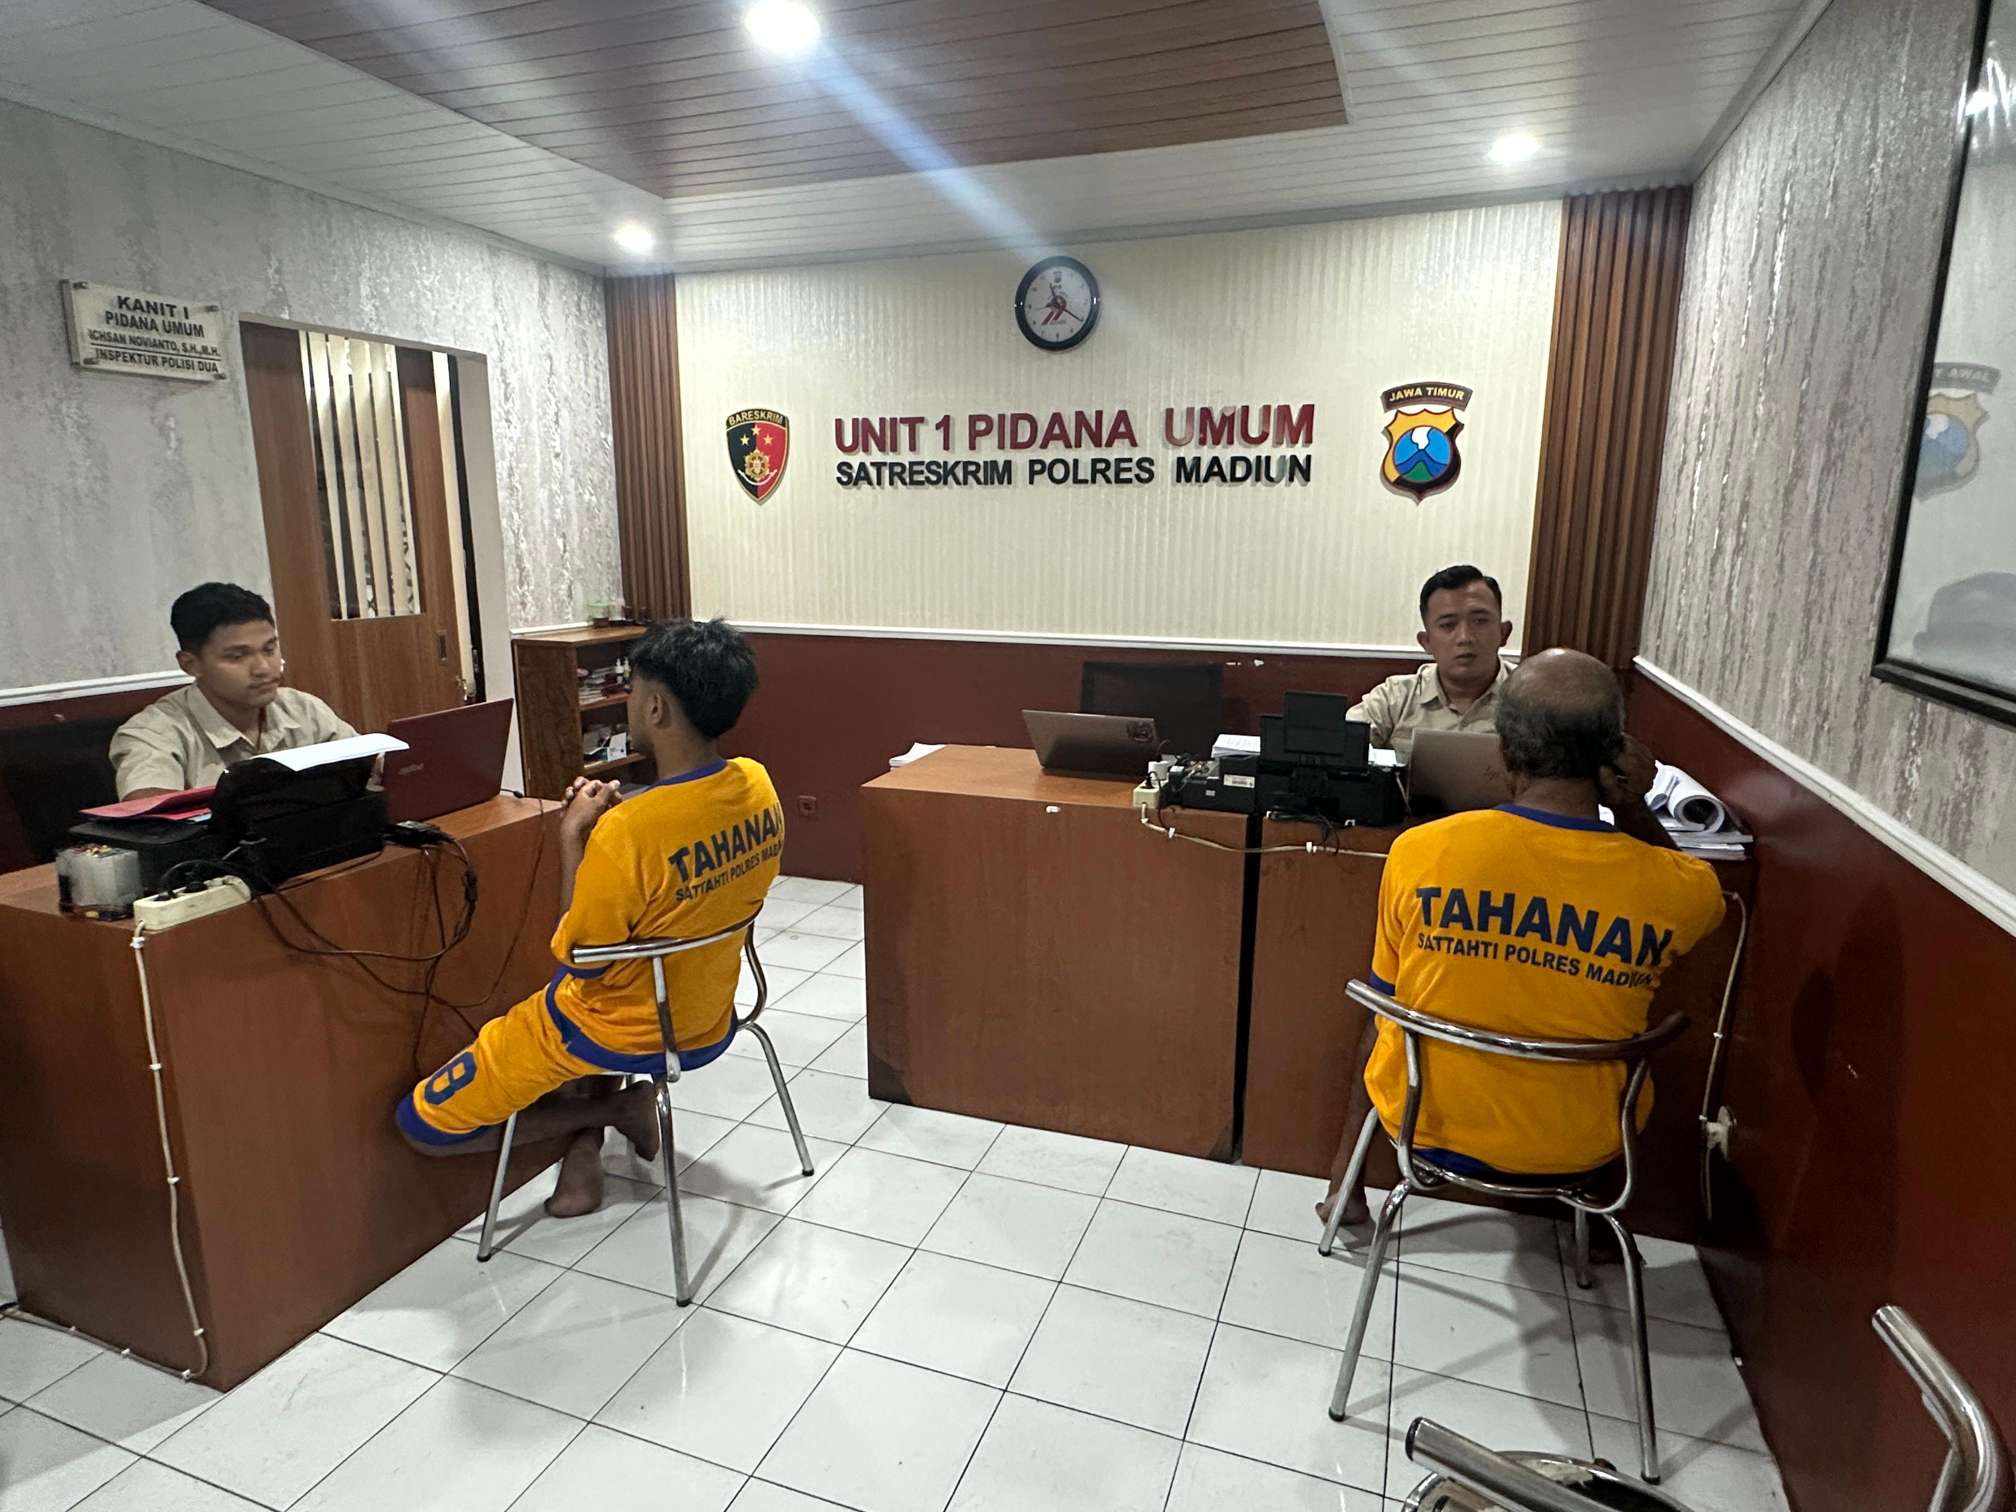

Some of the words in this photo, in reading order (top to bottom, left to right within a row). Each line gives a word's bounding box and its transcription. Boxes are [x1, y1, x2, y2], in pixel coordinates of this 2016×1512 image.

[117, 295, 177, 317] KANIT
[183, 306, 190, 319] I
[105, 310, 159, 332] PIDANA
[162, 319, 205, 338] UMUM
[96, 348, 159, 367] INSPEKTUR
[161, 355, 195, 371] POLISI
[197, 360, 219, 373] DUA
[1389, 387, 1423, 402] JAWA
[1426, 386, 1465, 400] TIMUR
[728, 410, 784, 426] BARESKRIM
[834, 416, 925, 453] UNIT
[935, 415, 951, 452] 1
[967, 409, 1138, 451] PIDANA
[1164, 403, 1315, 447] UMUM
[836, 459, 1013, 487] SATRESKRIM
[1028, 456, 1155, 485] POLRES
[1175, 454, 1312, 484] MADIUN
[675, 872, 730, 902] SATTAHTI
[730, 853, 760, 879] POLRES
[1416, 886, 1673, 967] TAHANAN
[1417, 932, 1498, 960] SATTAHTI
[1504, 943, 1580, 976] POLRES
[424, 1051, 477, 1105] 8
